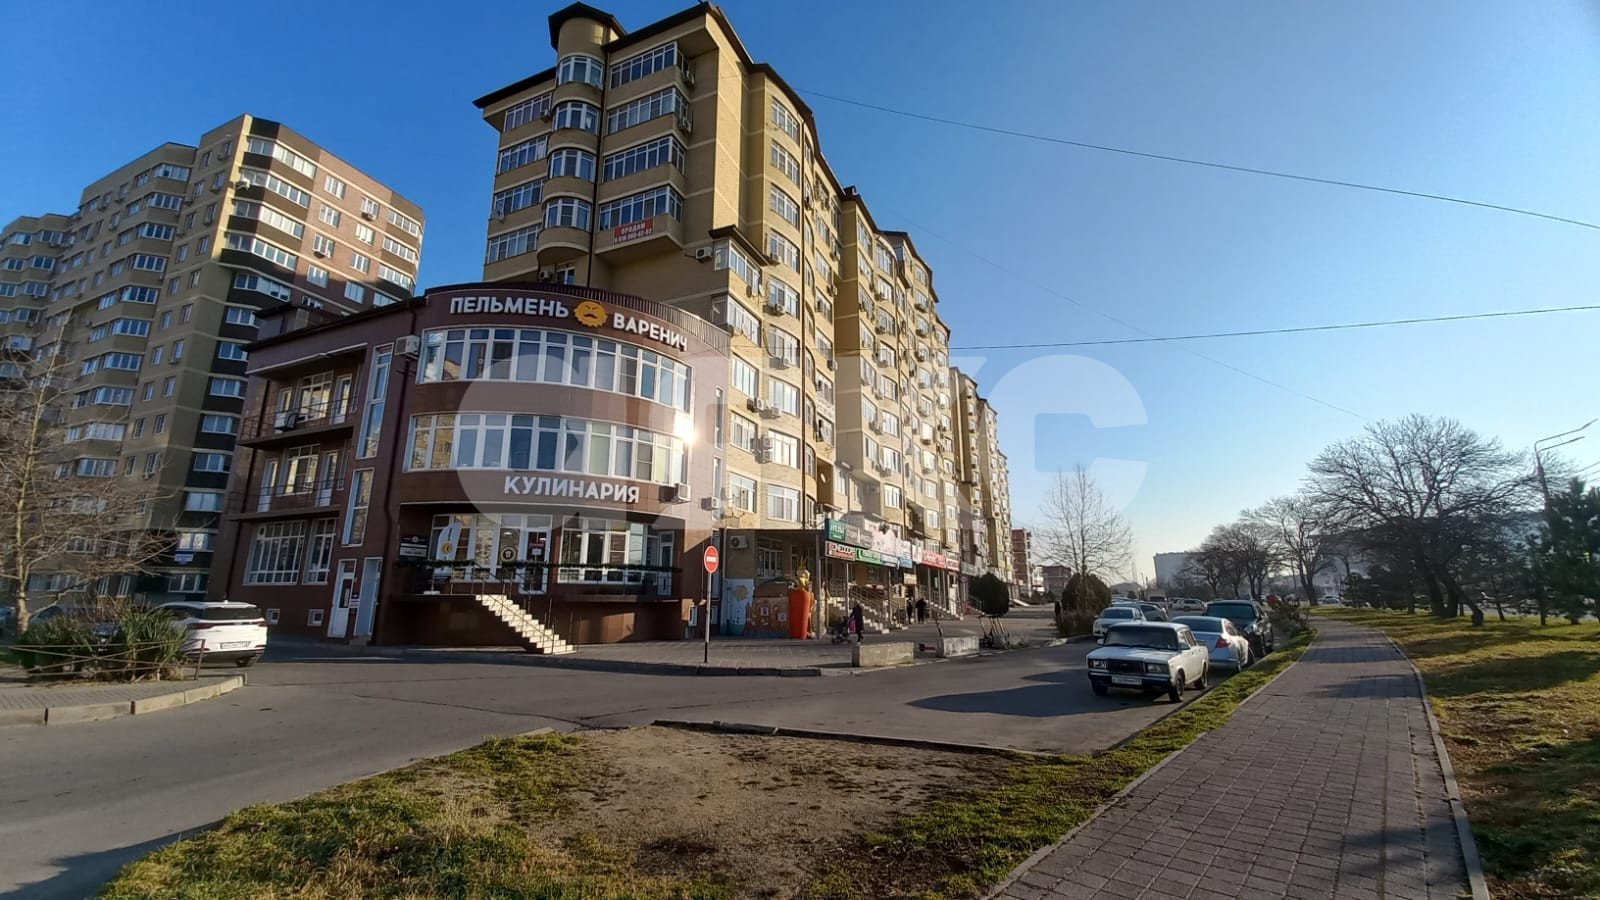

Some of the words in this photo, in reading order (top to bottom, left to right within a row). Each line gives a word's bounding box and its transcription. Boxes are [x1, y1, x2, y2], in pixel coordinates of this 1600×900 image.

[449, 296, 570, 319] ПЕЛЬМЕНЬ
[613, 312, 688, 351] ВАРЕНИЧ
[503, 475, 640, 504] КУЛИНАРИЯ
